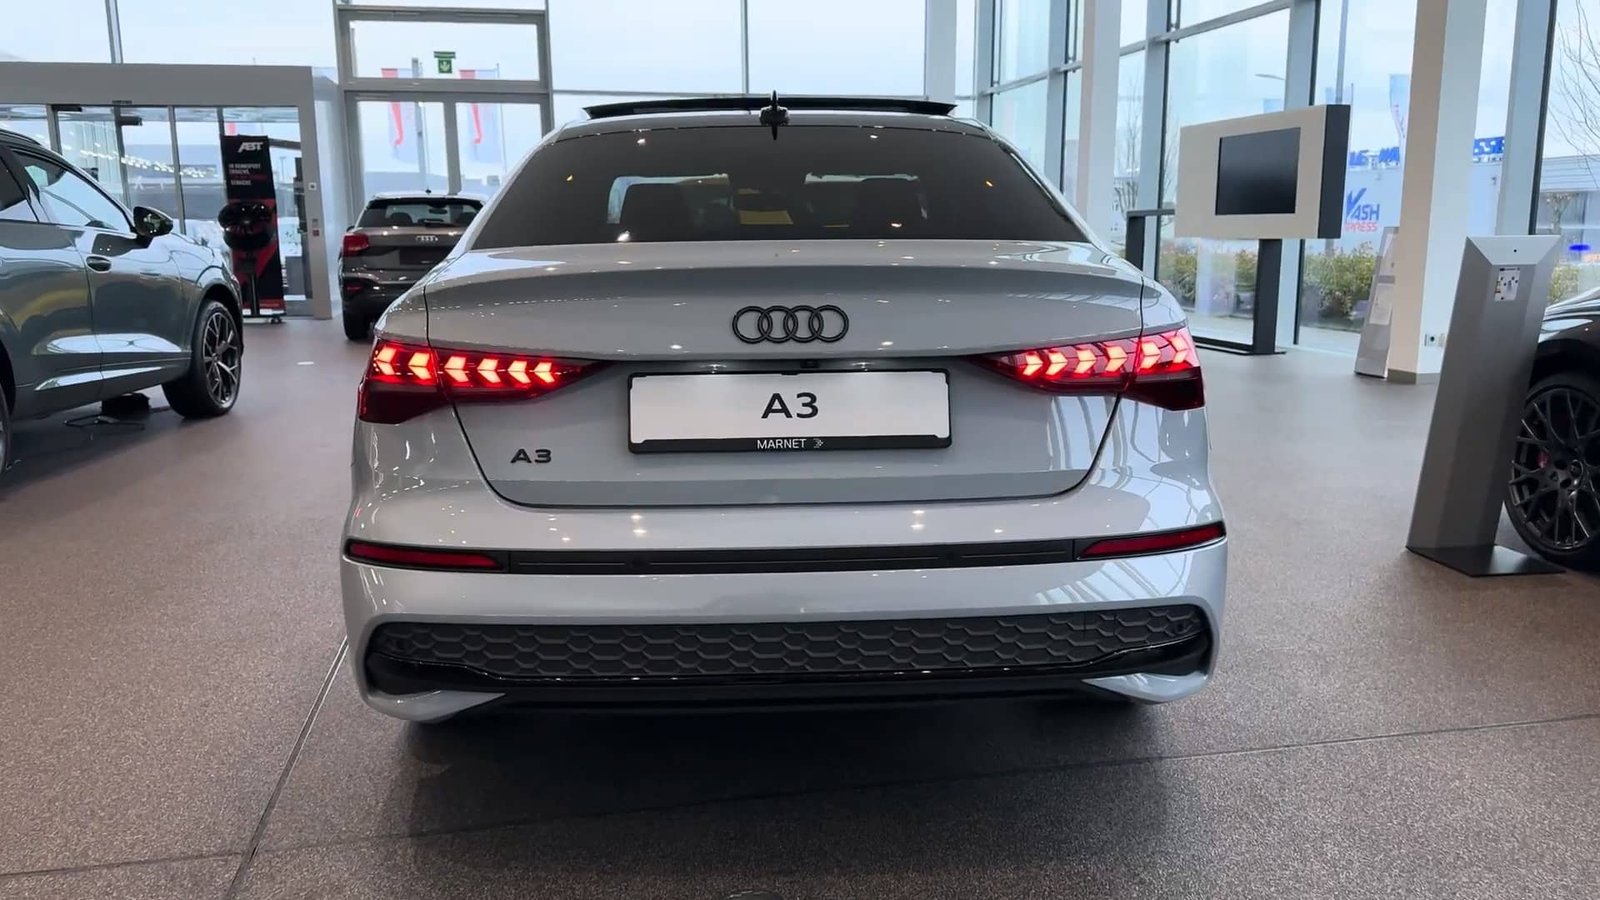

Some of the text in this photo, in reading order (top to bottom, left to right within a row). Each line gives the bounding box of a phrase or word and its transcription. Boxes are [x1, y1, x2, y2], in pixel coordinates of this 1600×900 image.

[237, 141, 264, 153] ABT
[761, 391, 819, 419] A3
[757, 438, 807, 450] MARNET
[510, 448, 552, 464] A3
